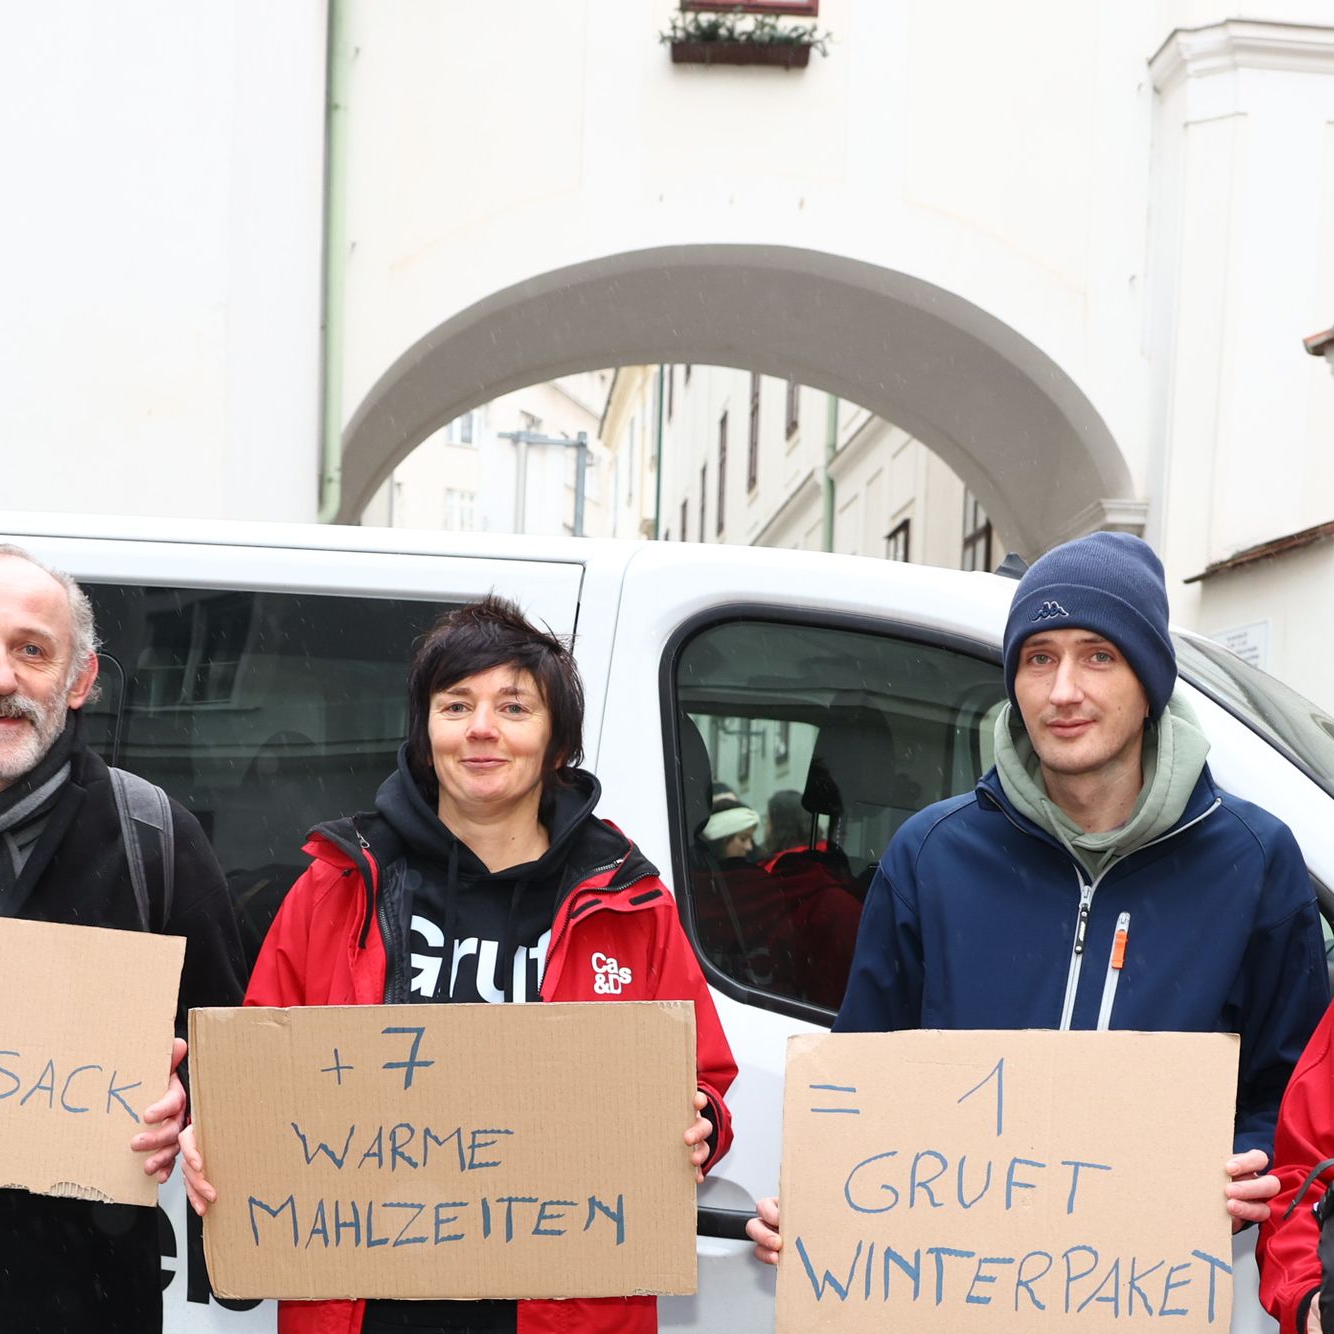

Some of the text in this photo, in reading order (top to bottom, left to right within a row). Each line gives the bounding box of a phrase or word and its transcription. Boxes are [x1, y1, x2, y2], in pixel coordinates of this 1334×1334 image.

[410, 914, 552, 1003] Gruf
[320, 1026, 435, 1090] + 7
[957, 1057, 1004, 1136] 1
[291, 1122, 515, 1173] WARME
[844, 1150, 1112, 1214] GRUFT
[248, 1194, 626, 1250] MAHLZEITEN
[795, 1237, 1234, 1324] WINTERPAKET
